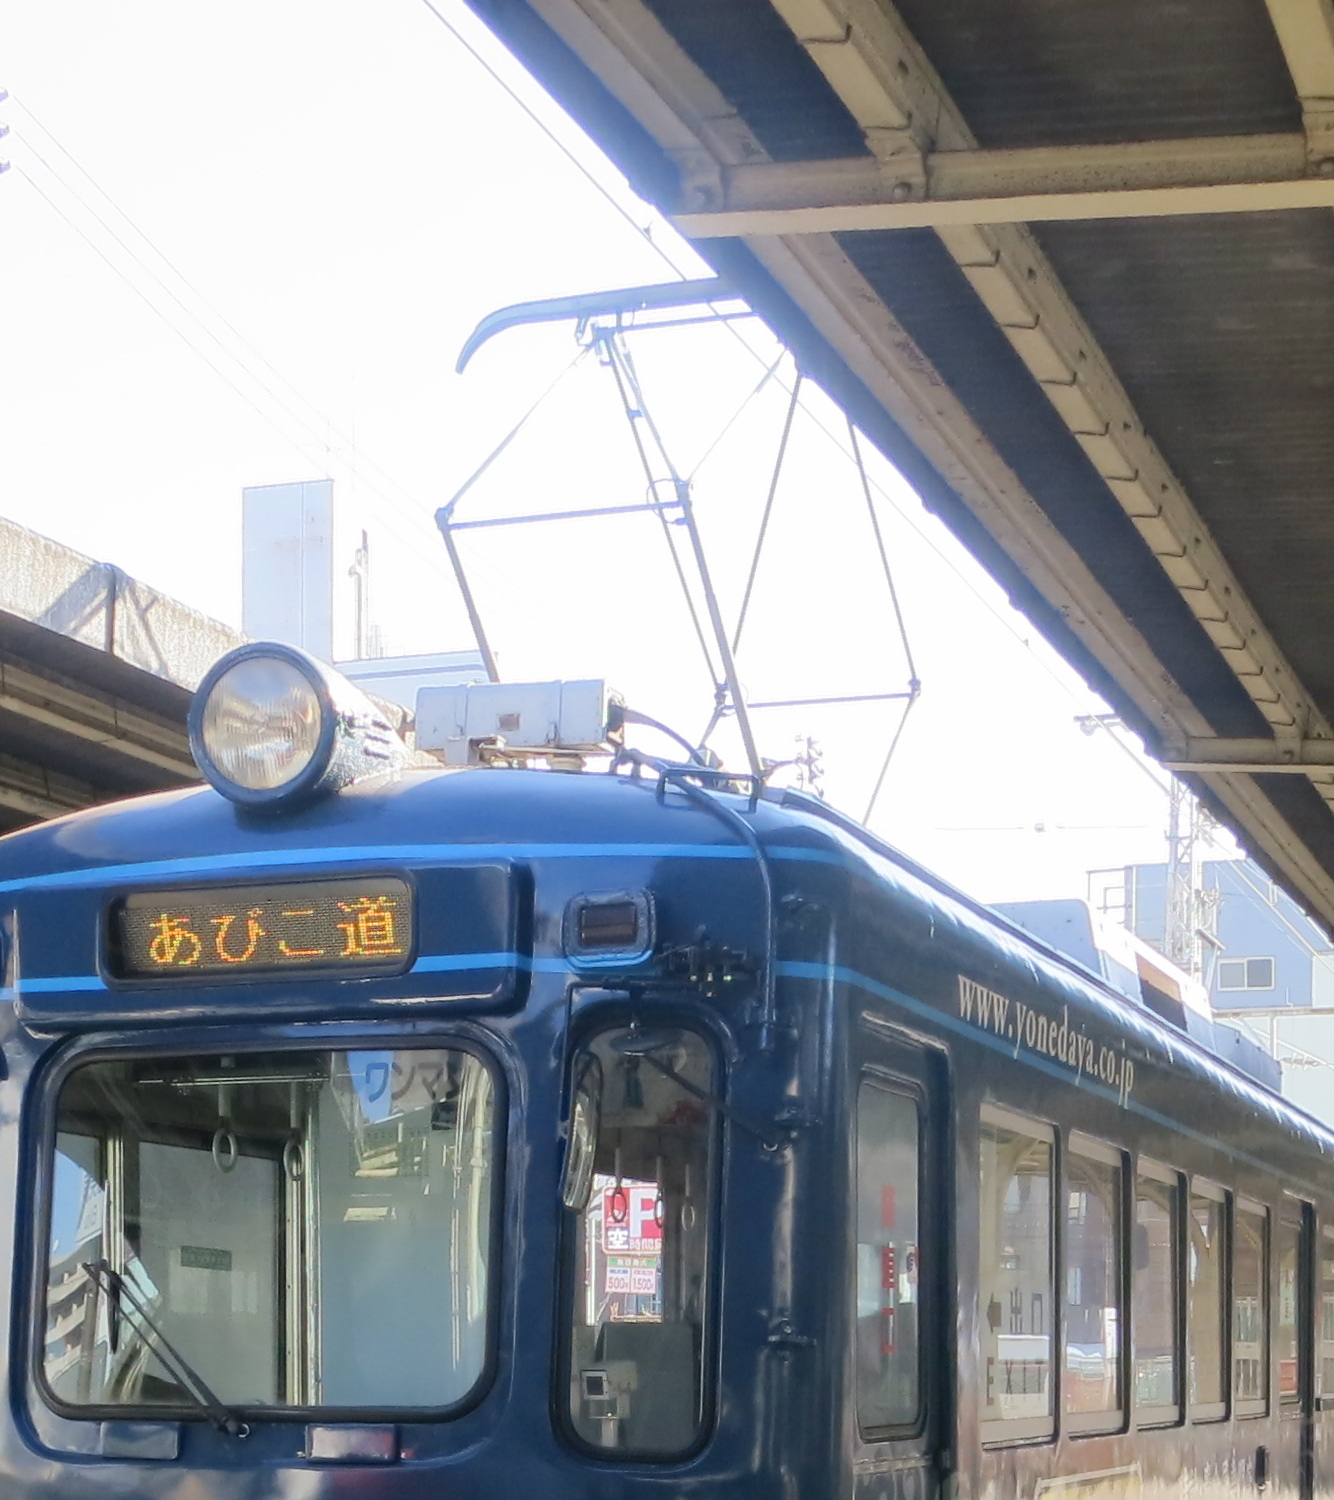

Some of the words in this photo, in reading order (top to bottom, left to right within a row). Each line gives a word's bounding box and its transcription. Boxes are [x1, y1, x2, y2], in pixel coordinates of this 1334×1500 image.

[150, 896, 403, 965] あびこ道
[958, 974, 1134, 1110] www.yonedaya.co.jp
